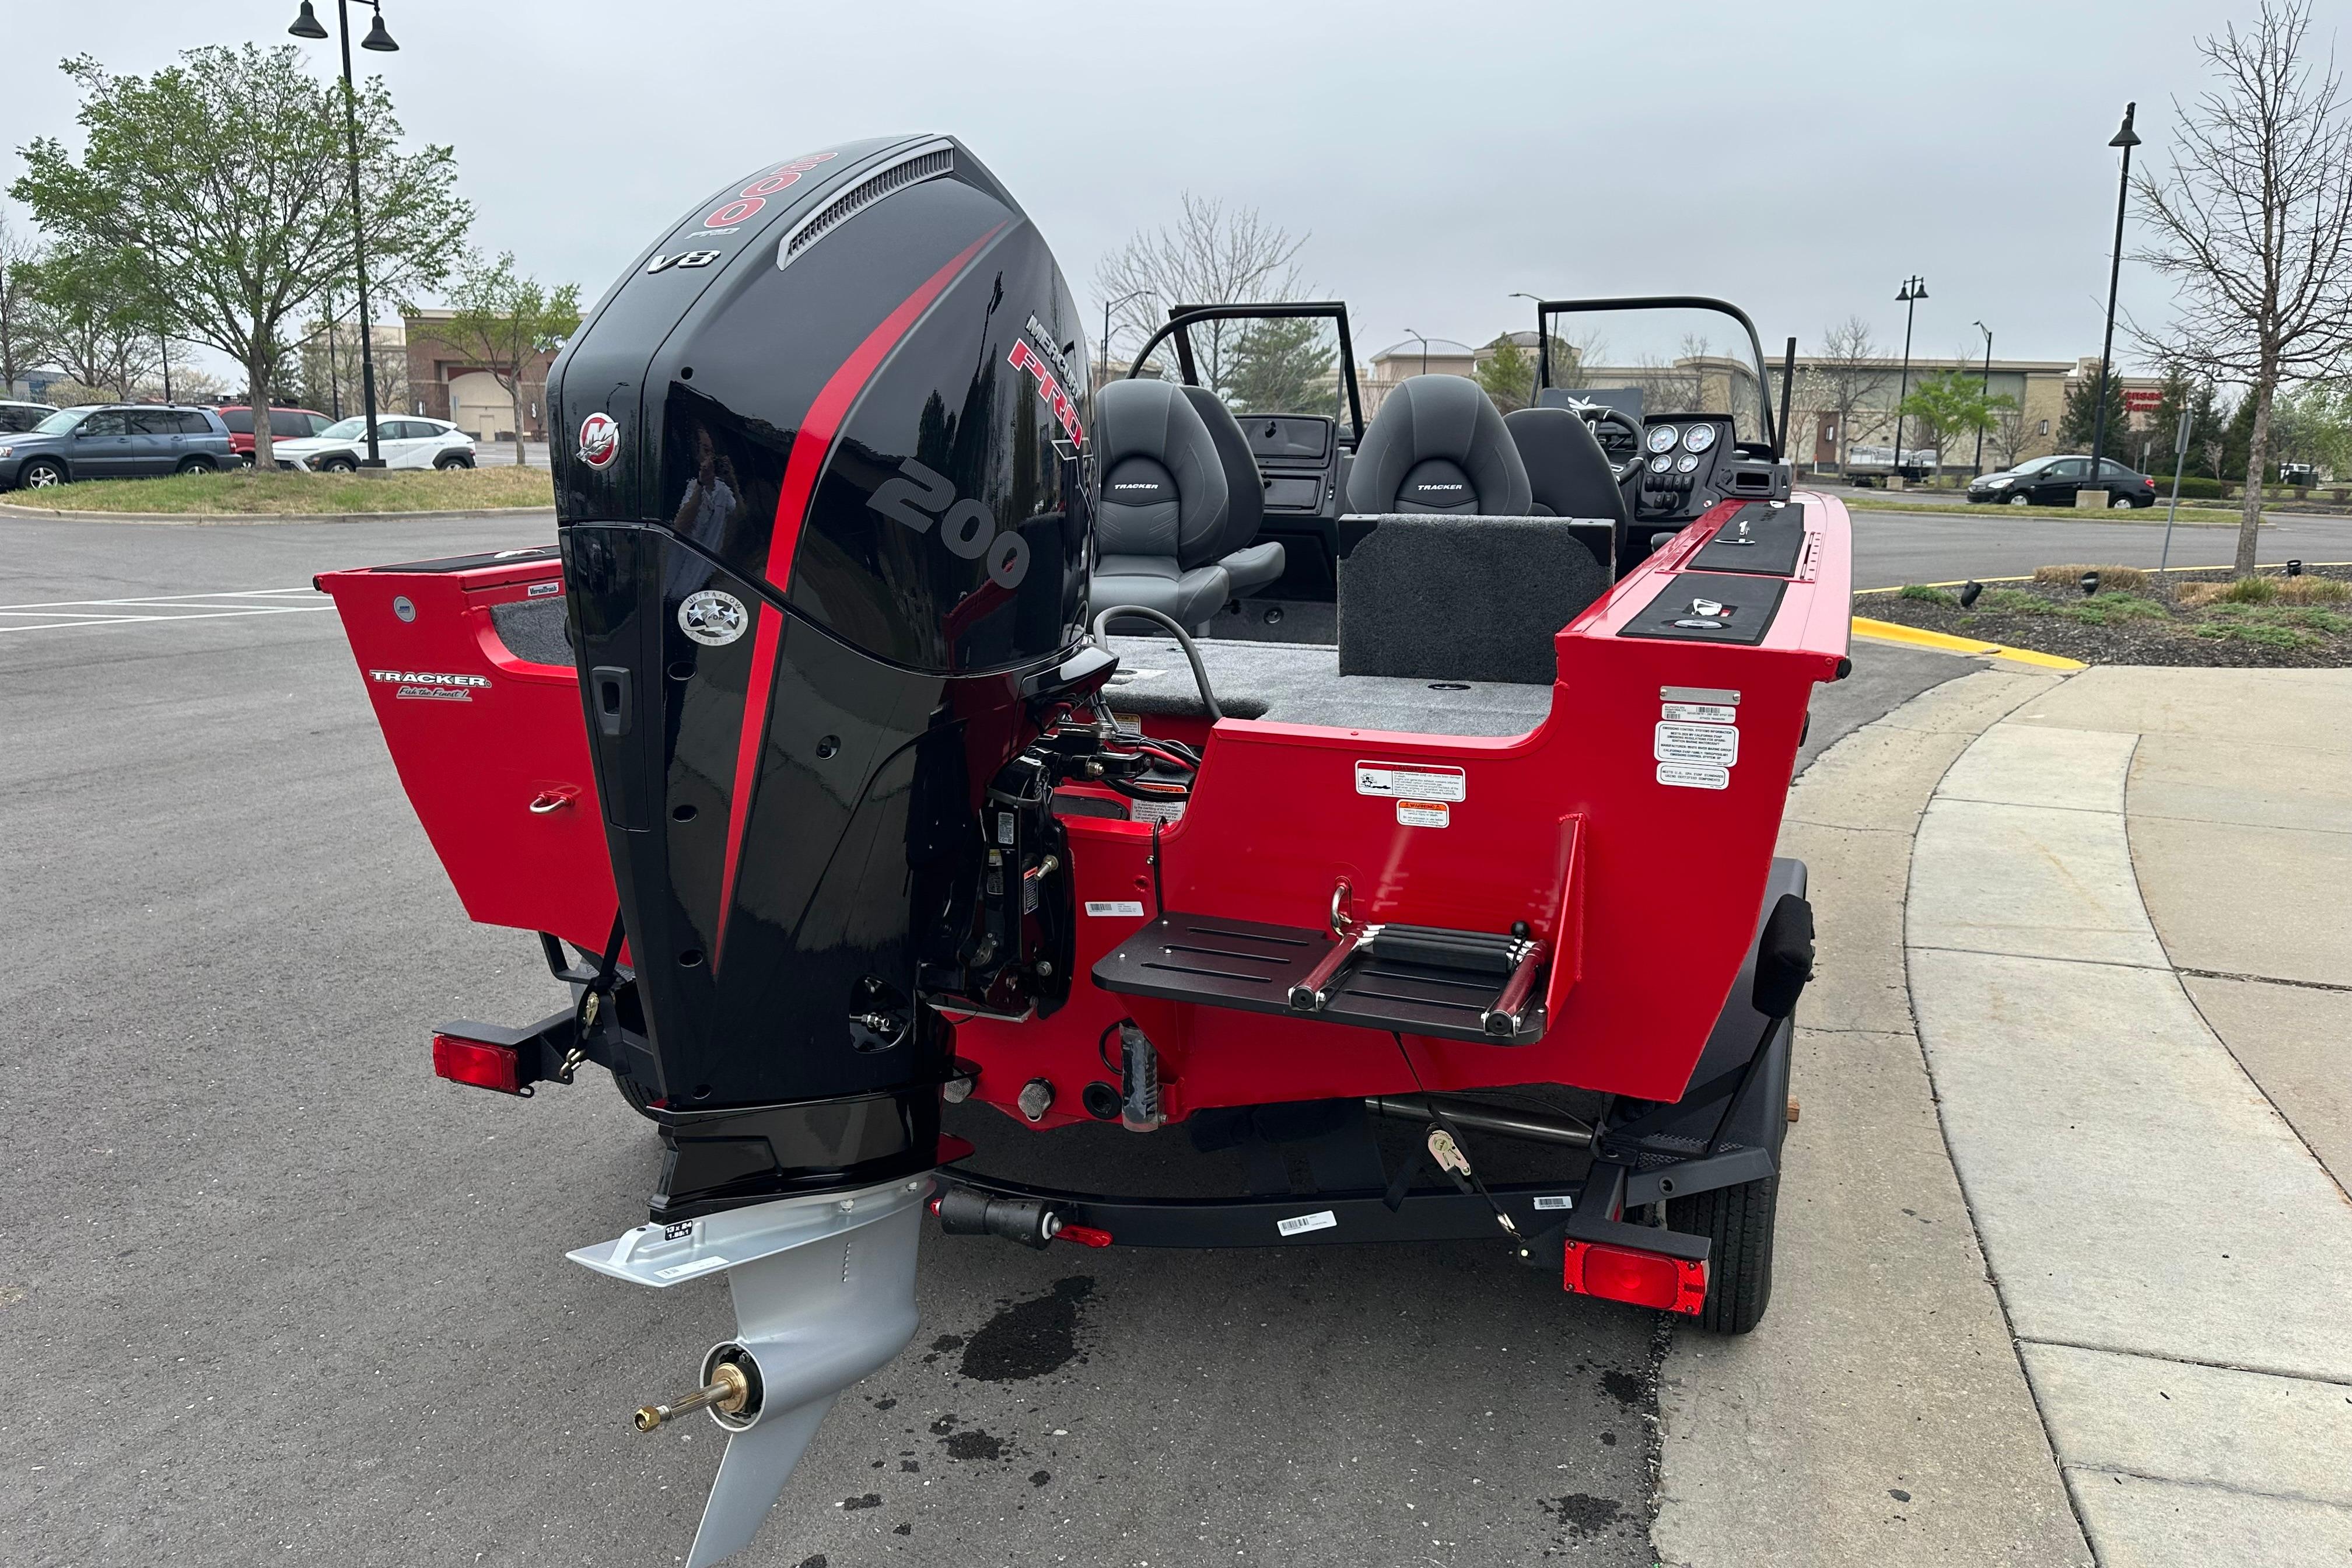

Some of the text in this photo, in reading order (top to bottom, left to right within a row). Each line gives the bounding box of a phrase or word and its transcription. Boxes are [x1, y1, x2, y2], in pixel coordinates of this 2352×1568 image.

[647, 250, 721, 274] V8
[1007, 338, 1083, 450] PRO
[866, 457, 1030, 589] 200
